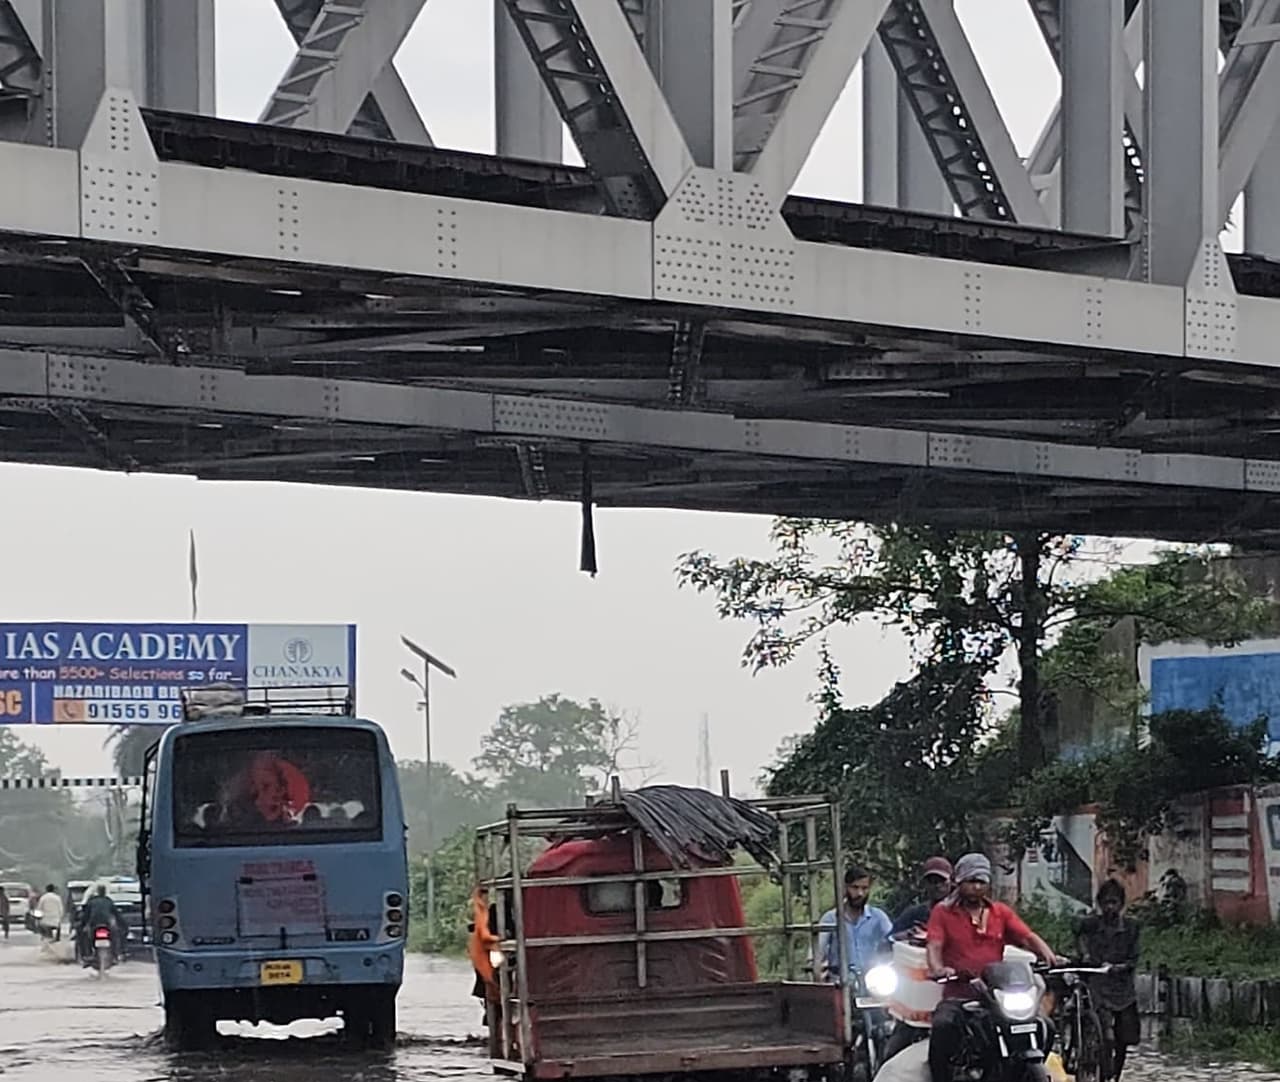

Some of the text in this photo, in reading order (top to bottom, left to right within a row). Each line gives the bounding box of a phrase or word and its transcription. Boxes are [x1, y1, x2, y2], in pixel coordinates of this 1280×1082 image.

[5, 632, 59, 660] IAS
[69, 631, 242, 660] ACADEMY
[23, 666, 56, 680] than
[59, 666, 105, 680] 5500+
[109, 665, 184, 681] Selections
[187, 670, 205, 681] so
[252, 665, 343, 678] CHANAKYA
[88, 703, 181, 719] 91555 96
